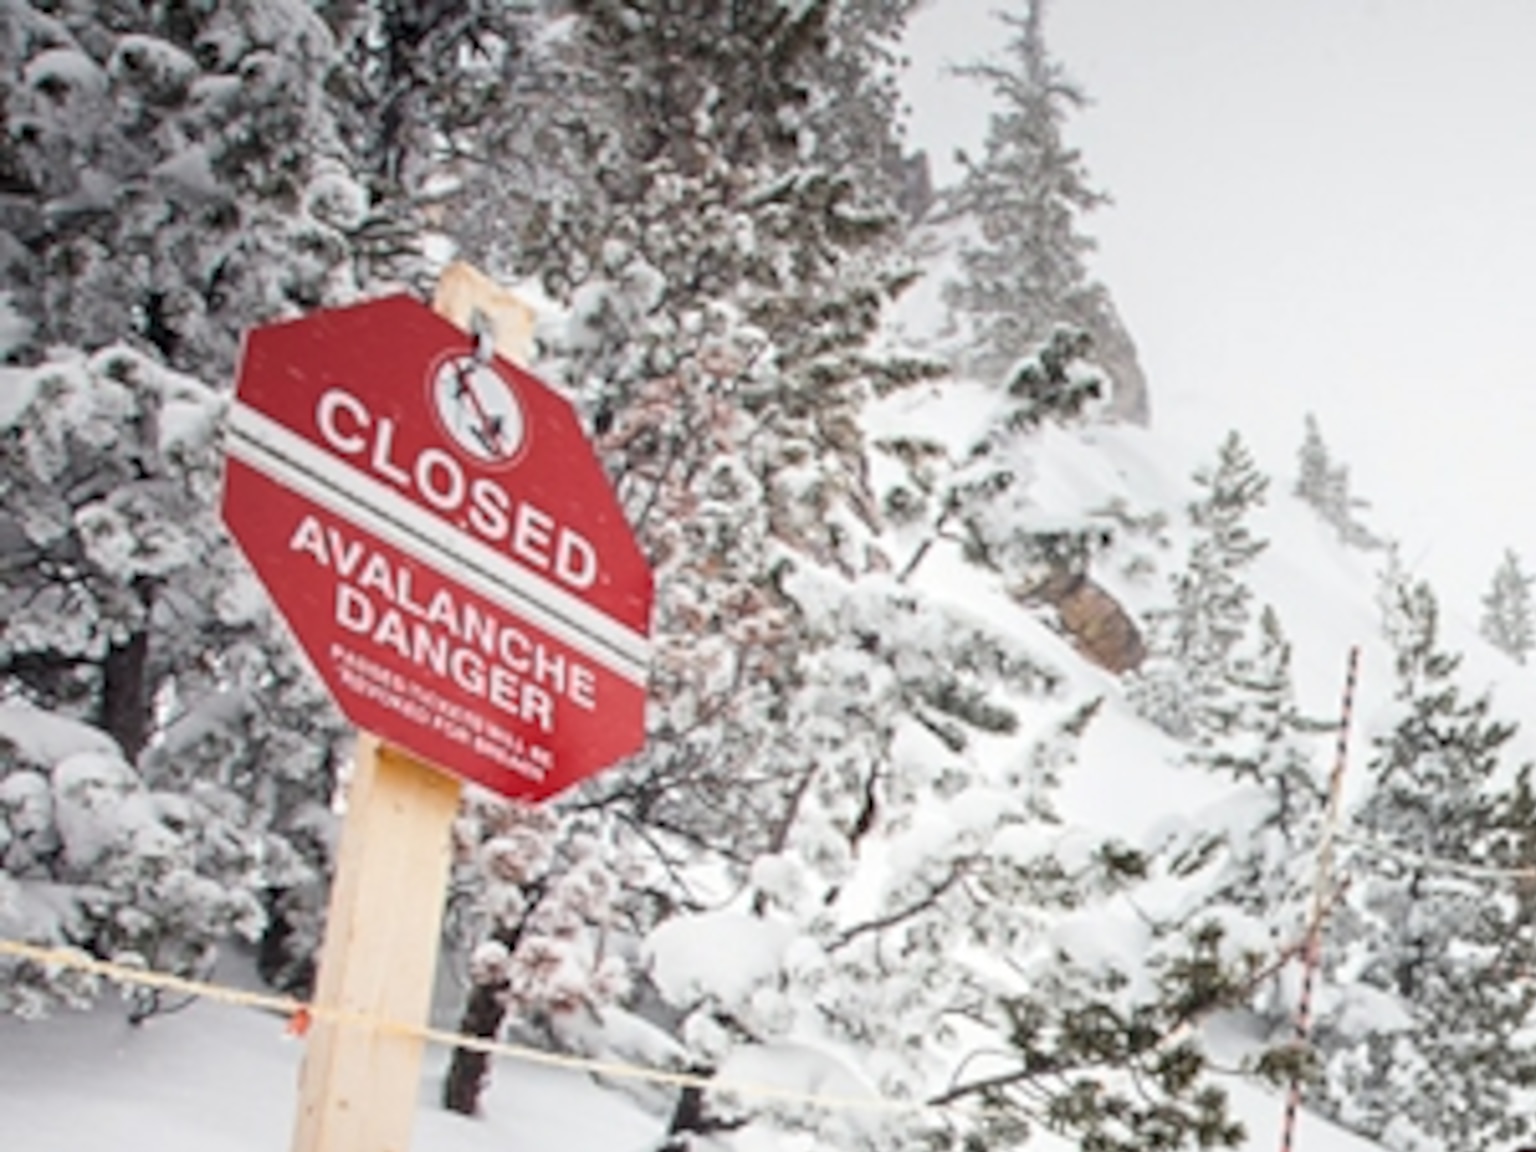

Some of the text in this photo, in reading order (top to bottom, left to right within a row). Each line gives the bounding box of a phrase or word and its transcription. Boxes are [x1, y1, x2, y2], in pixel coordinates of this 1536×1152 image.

[315, 388, 597, 591] CLOSED
[288, 514, 597, 711] AVALANCHE
[334, 585, 555, 732] DANGER
